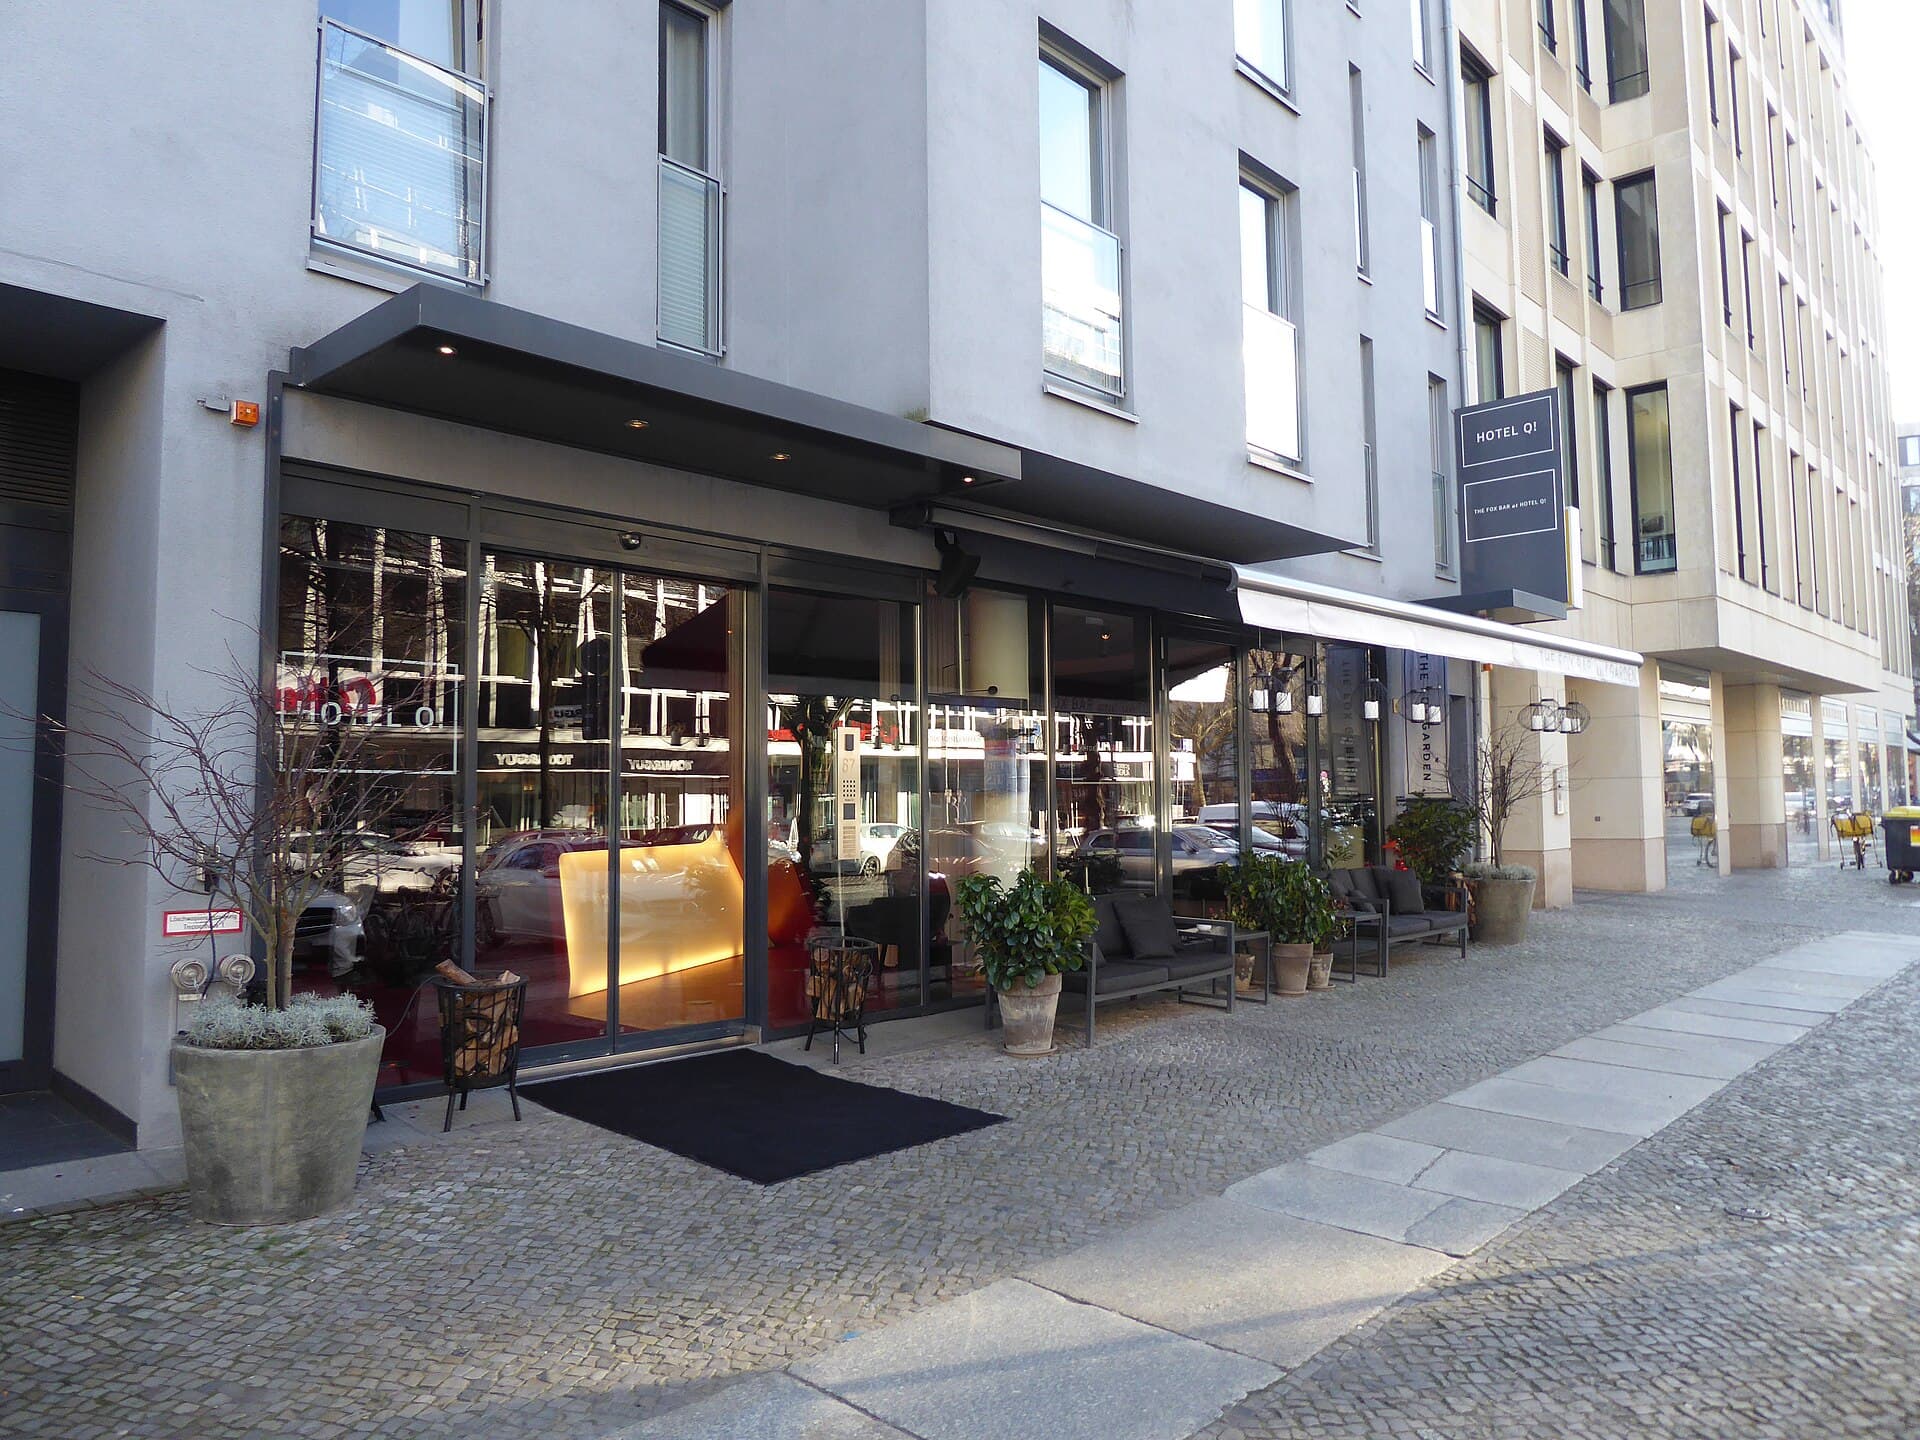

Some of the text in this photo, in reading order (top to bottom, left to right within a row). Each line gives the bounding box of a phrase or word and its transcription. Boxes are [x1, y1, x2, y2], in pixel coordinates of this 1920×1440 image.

[1476, 421, 1537, 443] HOTEL Q!
[1486, 505, 1498, 513] FOX
[1498, 503, 1511, 511] BAR
[1519, 499, 1539, 508] HOTEL
[1419, 653, 1430, 681] THE
[1421, 721, 1432, 781] GARDEN
